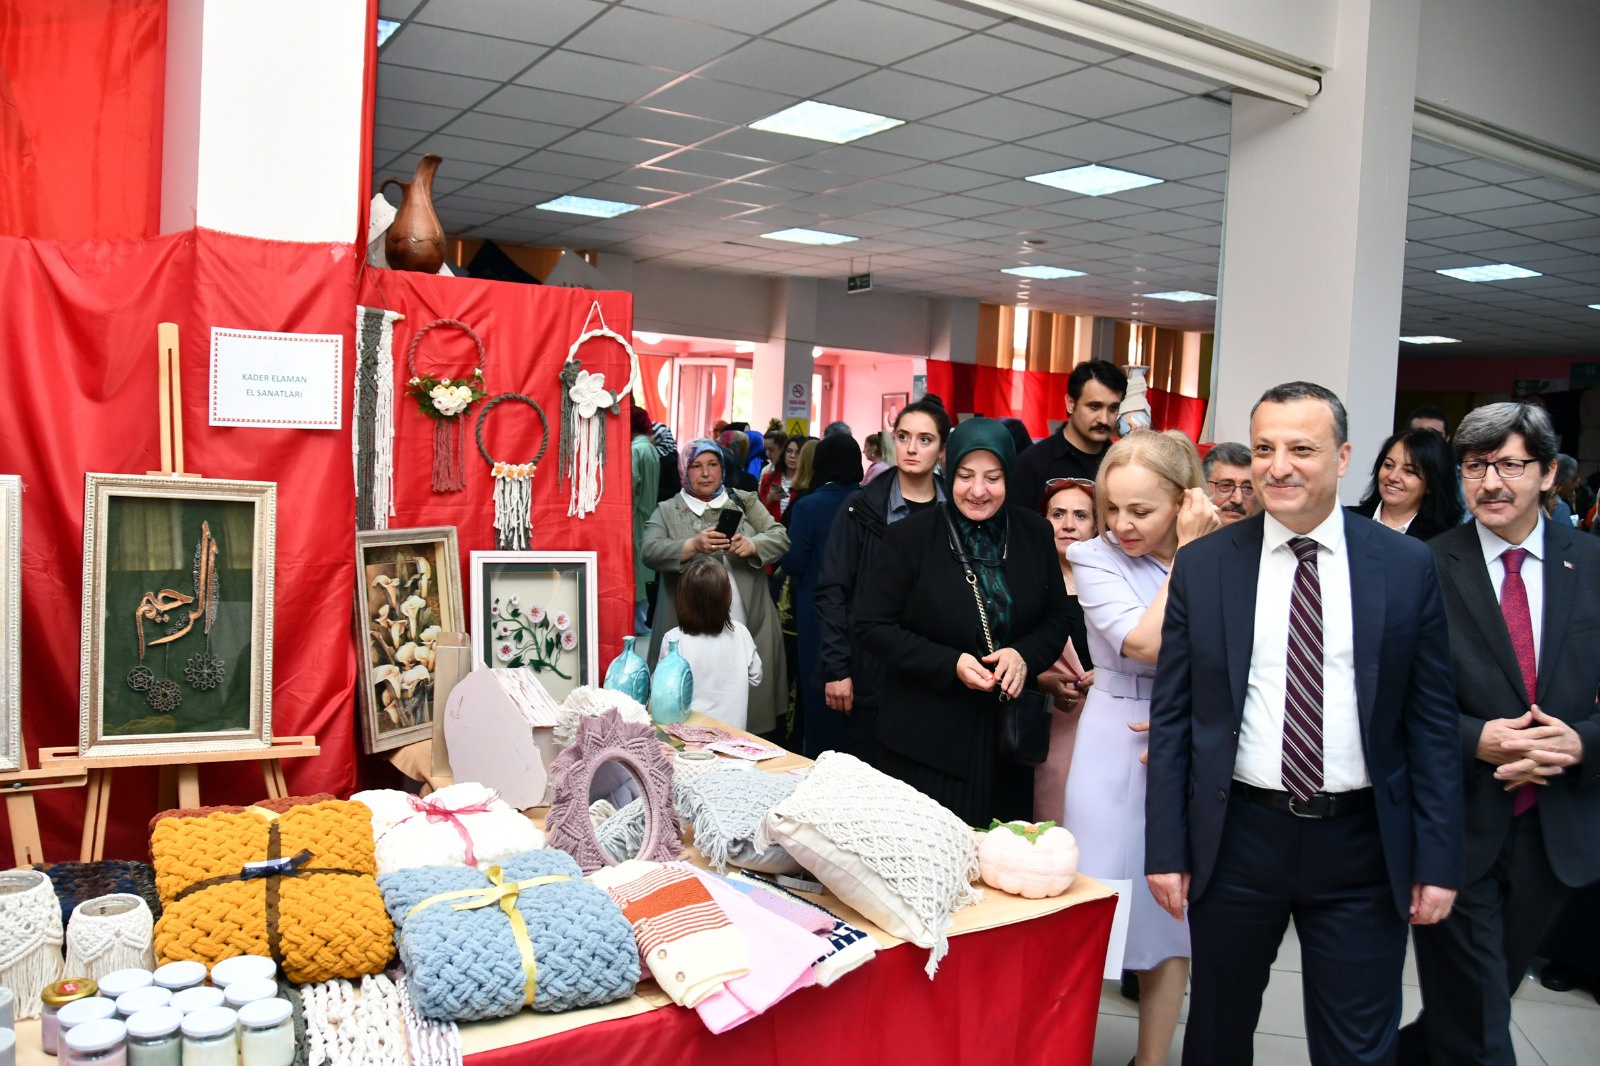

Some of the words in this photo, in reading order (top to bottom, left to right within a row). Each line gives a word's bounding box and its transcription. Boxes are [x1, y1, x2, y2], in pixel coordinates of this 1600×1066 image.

[242, 373, 269, 382] KADER
[271, 375, 307, 383] ELAMAN
[246, 388, 255, 397] EL
[257, 389, 303, 398] SANATLARI
